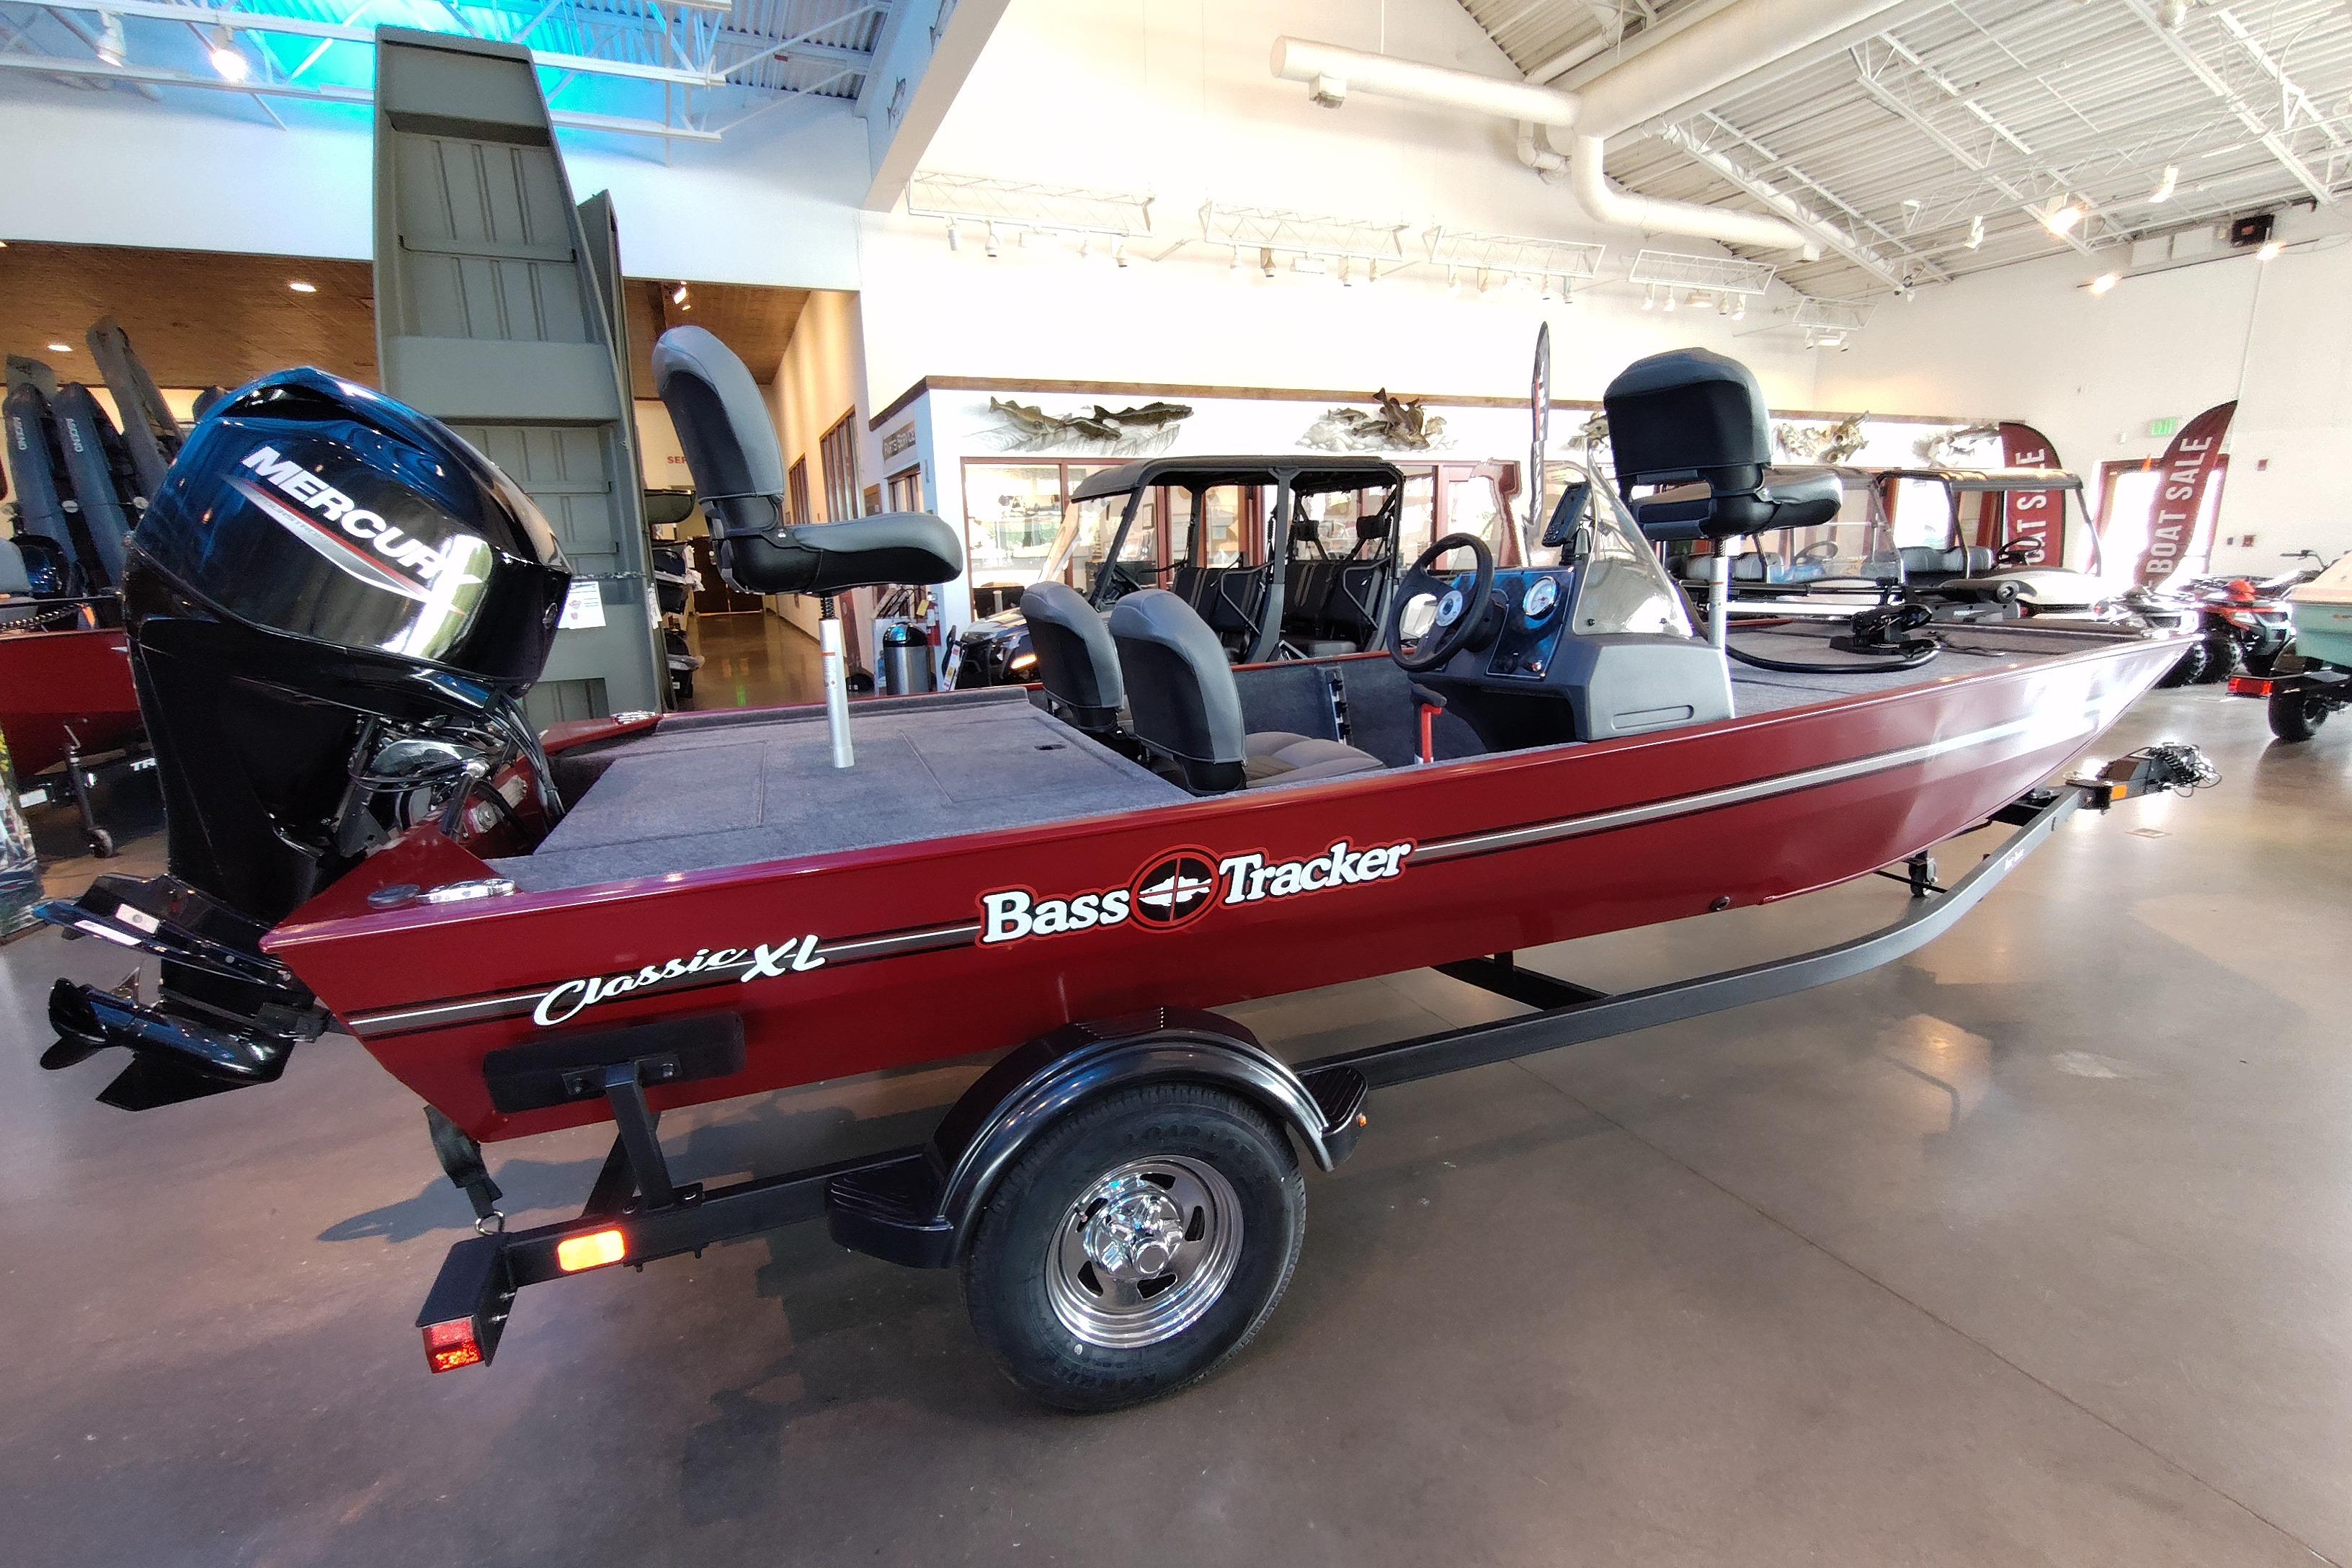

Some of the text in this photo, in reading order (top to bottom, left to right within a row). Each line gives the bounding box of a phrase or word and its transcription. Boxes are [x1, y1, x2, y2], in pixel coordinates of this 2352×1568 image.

[2150, 417, 2175, 435] EXIT
[2015, 448, 2047, 566] OAT SE
[2145, 436, 2214, 574] BOAT SALE
[130, 757, 156, 772] TR
[983, 841, 1412, 943] Bass Tracker
[533, 934, 826, 1026] Classic XL
